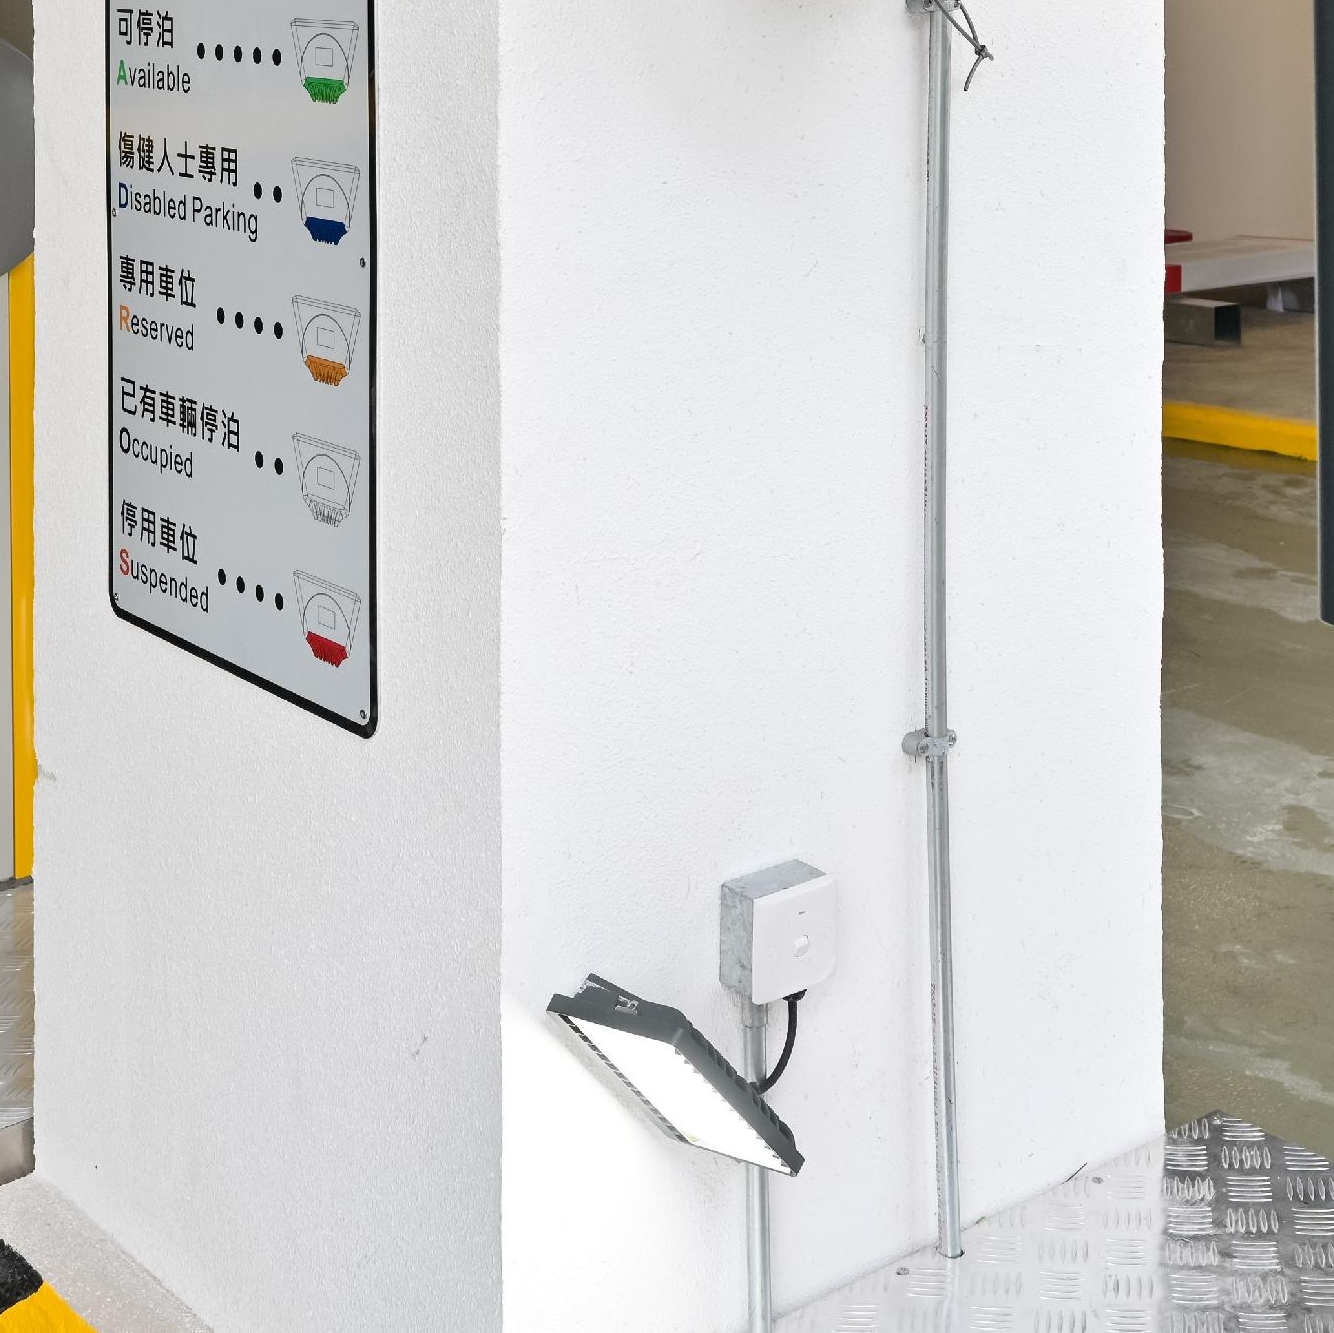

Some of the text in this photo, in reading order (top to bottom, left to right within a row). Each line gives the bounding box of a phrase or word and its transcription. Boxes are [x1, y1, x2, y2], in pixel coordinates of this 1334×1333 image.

[116, 8, 174, 49] 可停泊
[116, 59, 191, 94] Available
[118, 130, 238, 187] 傷健人士專用
[118, 182, 258, 242] Disabled Parking
[119, 254, 196, 308] 專用車位
[119, 304, 194, 351] Reserved
[120, 376, 240, 453] 已有車輛停泊
[119, 427, 193, 478] Occupied
[120, 499, 198, 565] 停用車位
[119, 549, 208, 613] Suspended
